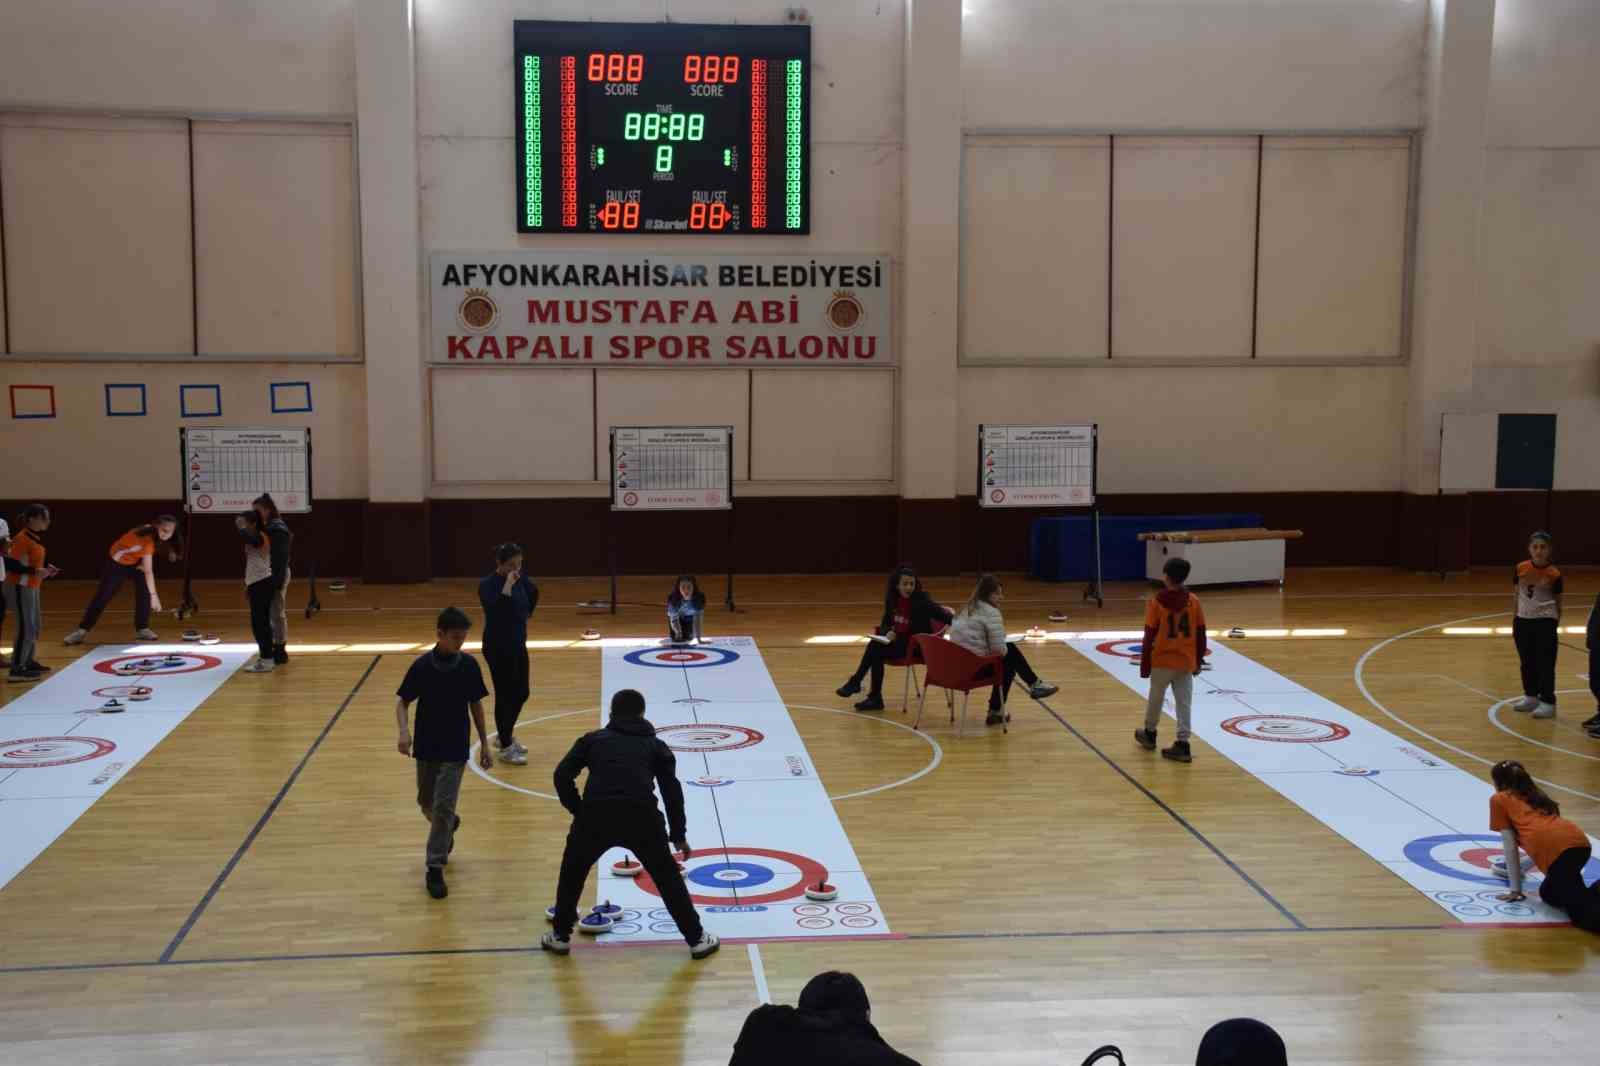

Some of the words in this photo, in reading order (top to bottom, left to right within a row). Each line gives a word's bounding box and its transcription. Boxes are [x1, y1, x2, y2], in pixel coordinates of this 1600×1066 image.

[588, 54, 644, 82] 888
[684, 55, 739, 83] 888
[605, 84, 638, 96] SCORE
[690, 84, 724, 97] SCORE
[656, 104, 672, 113] TIME
[624, 113, 704, 140] 88:88
[656, 145, 672, 172] 8
[604, 202, 640, 228] 88
[690, 203, 725, 229] 88
[442, 260, 708, 288] AFYONKARAHİSAR
[718, 260, 882, 288] BELEDİYESİ
[527, 300, 718, 324] MUSTAFA
[732, 295, 799, 324] ABİ
[447, 336, 593, 360] KAPALI
[609, 336, 710, 360] SPOR
[726, 336, 877, 360] SALONU
[1527, 584, 1536, 599] 5
[1167, 610, 1191, 638] 14
